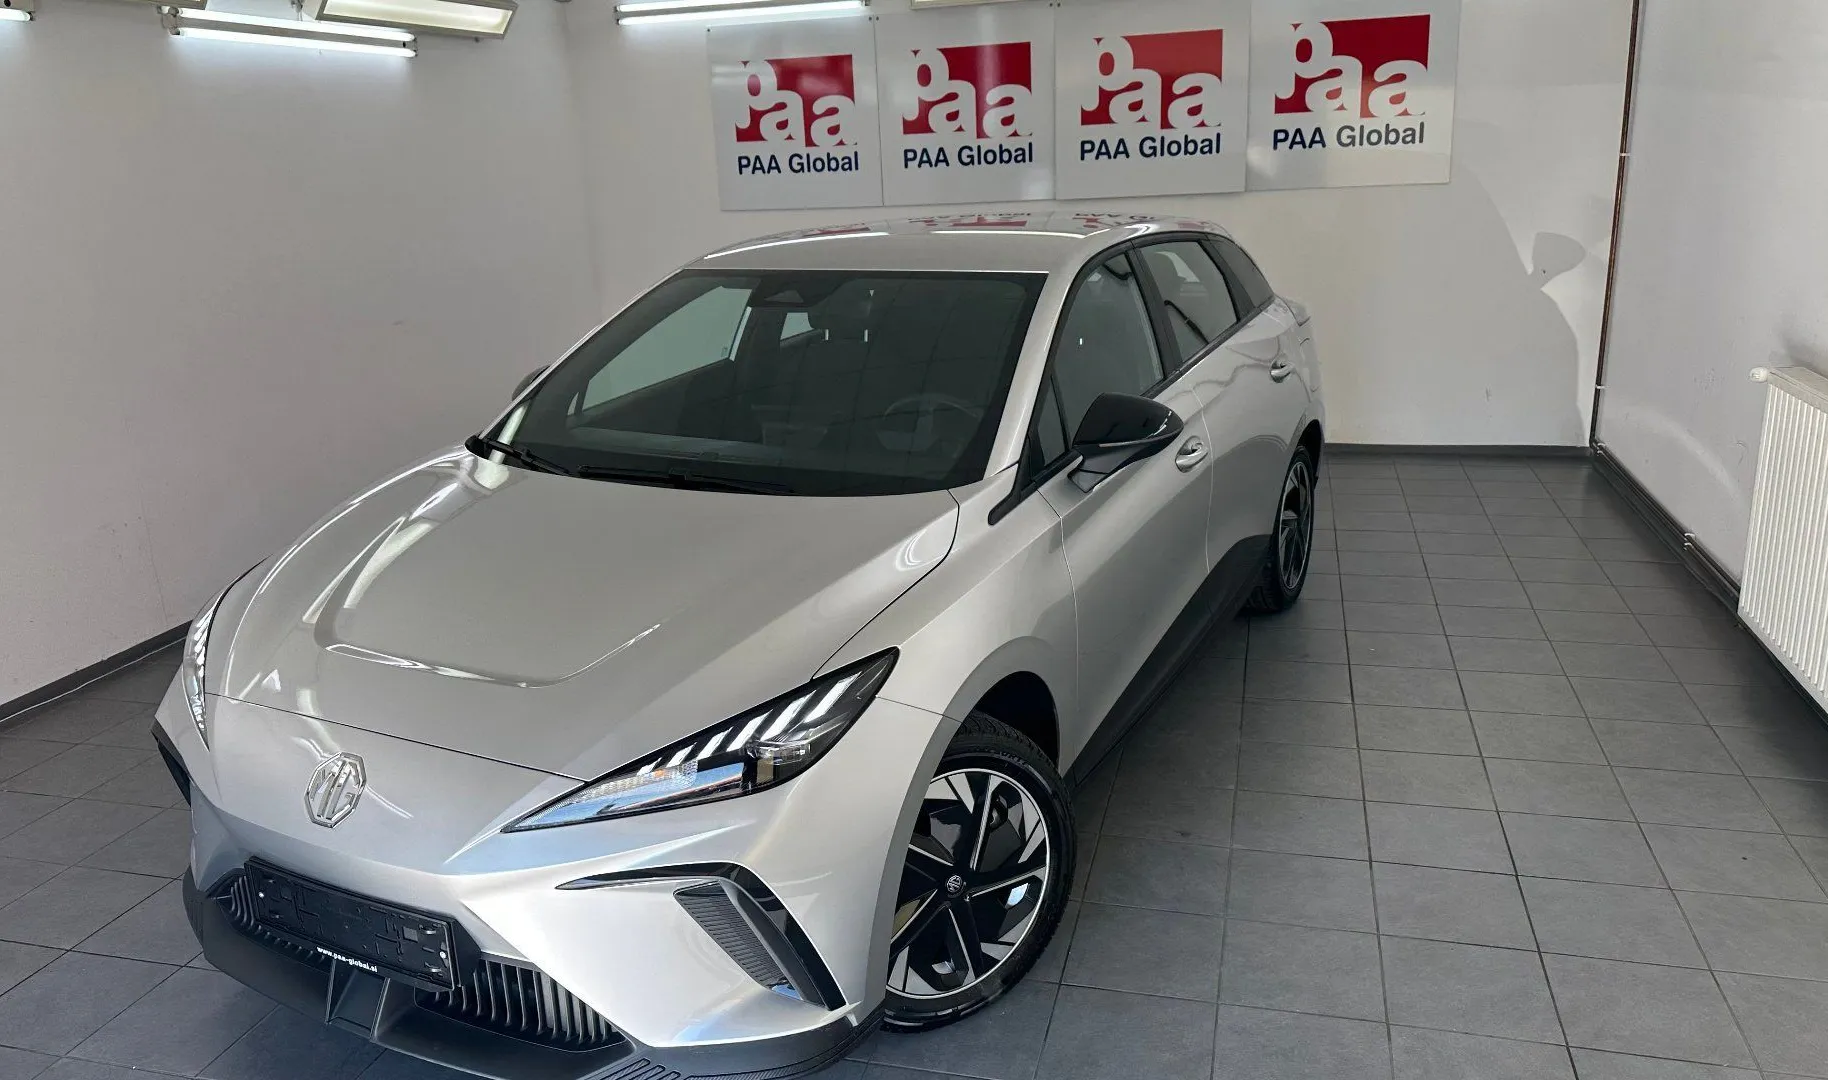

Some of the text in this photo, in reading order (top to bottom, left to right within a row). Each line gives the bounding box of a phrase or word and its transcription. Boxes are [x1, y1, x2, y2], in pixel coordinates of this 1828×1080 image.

[1080, 132, 1221, 162] PAA Global
[1272, 121, 1425, 151] PAA Global
[737, 150, 860, 175] PAA Global
[903, 141, 1034, 169] PAA Global
[316, 946, 378, 973] www.paa-global.si
